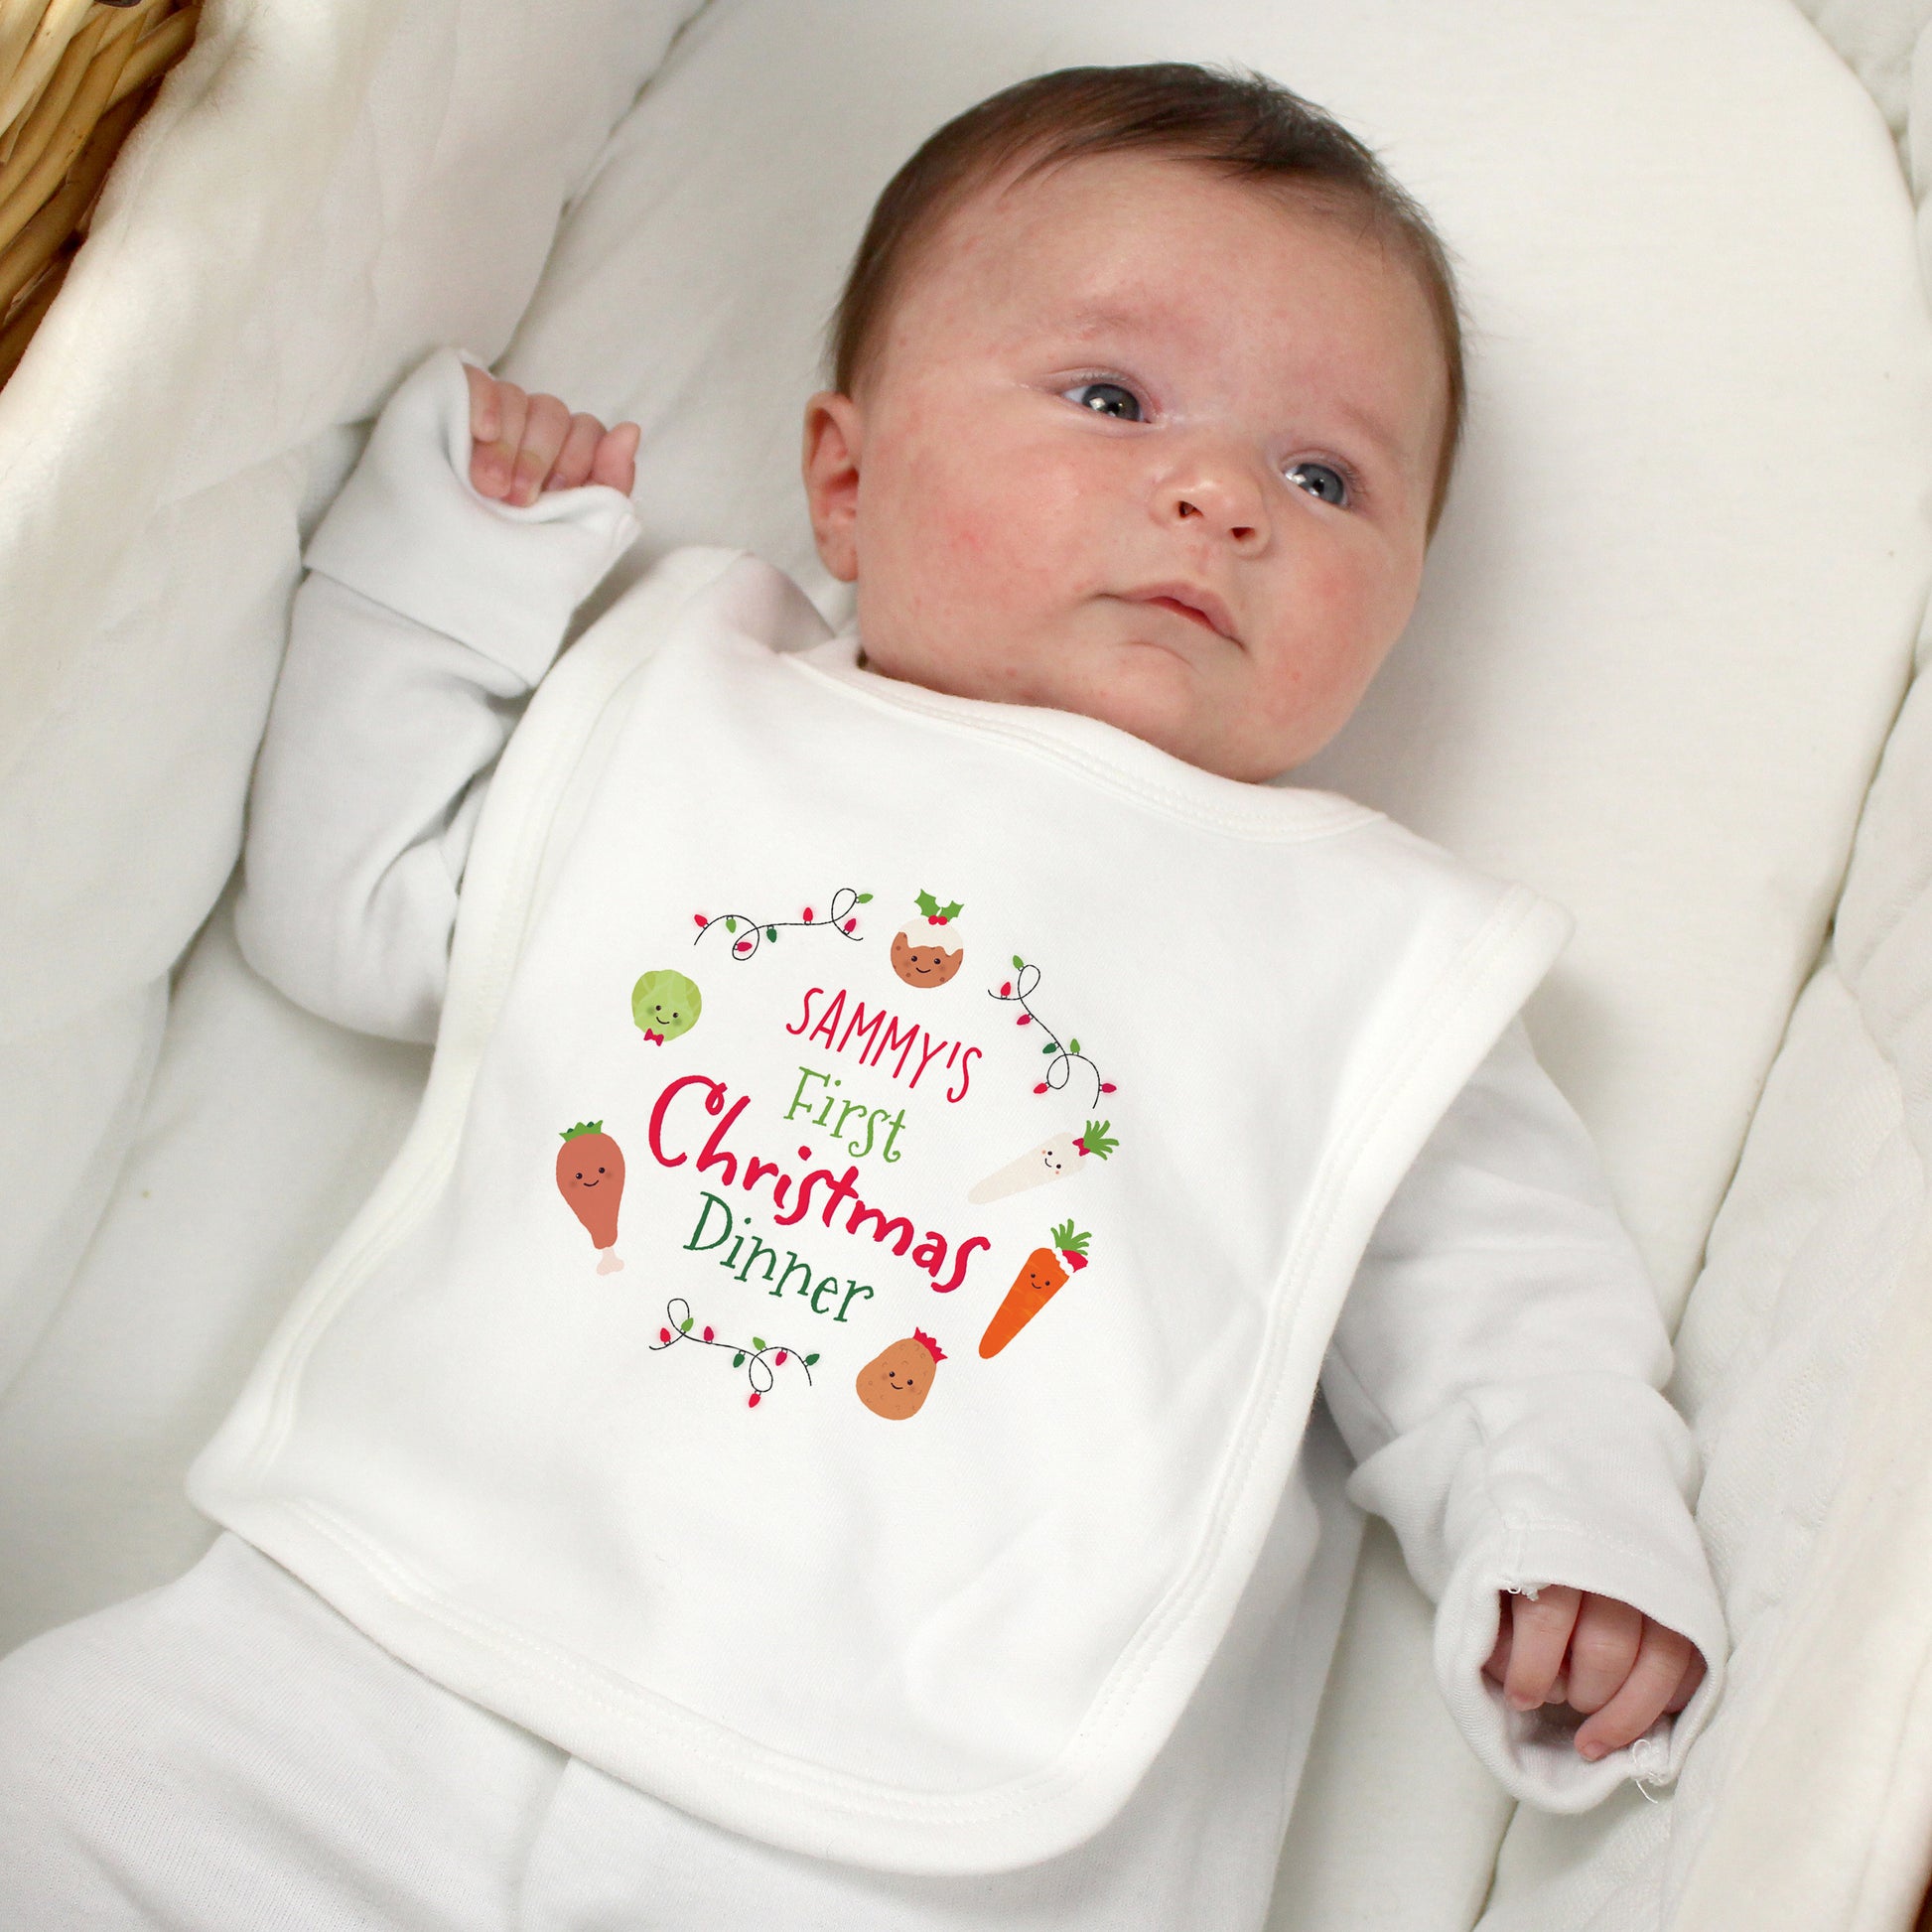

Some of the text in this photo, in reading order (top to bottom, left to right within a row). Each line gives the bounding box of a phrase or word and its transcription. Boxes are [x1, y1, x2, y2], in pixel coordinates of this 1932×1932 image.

[785, 987, 983, 1103] SAMMY'S
[783, 1066, 906, 1164] First
[647, 1074, 991, 1294] Christmas
[683, 1191, 875, 1322] Dinner
